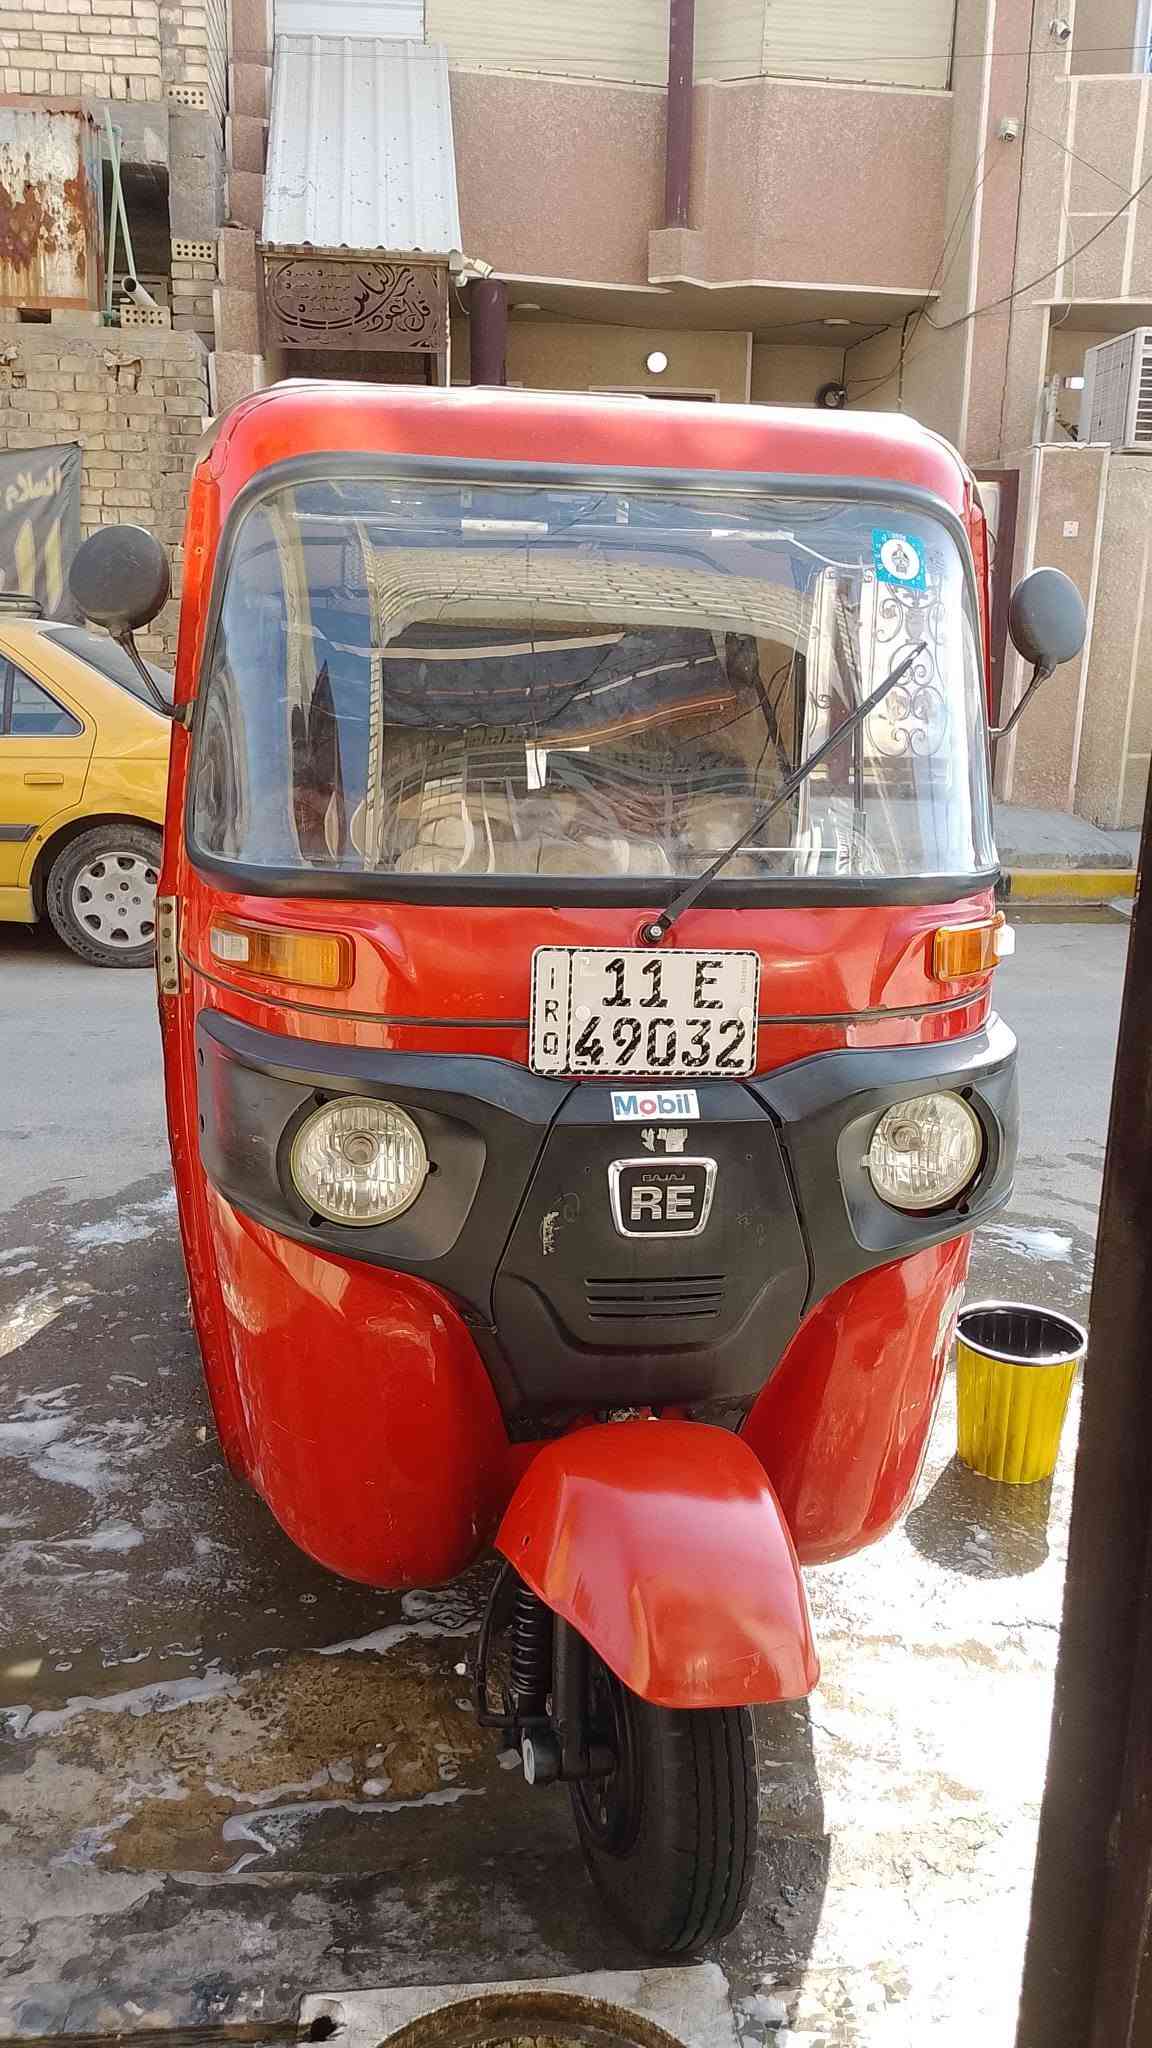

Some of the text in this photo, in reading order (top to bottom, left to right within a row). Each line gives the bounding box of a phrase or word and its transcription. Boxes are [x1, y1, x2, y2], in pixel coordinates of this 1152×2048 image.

[6, 466, 63, 511] السلام
[602, 958, 669, 1008] 11
[693, 960, 723, 1009] E
[543, 967, 559, 1055] IRQ
[574, 1016, 746, 1068] 49032
[613, 1094, 692, 1115] Mobil
[642, 1174, 686, 1183] BAJAJ
[630, 1185, 696, 1221] RE
